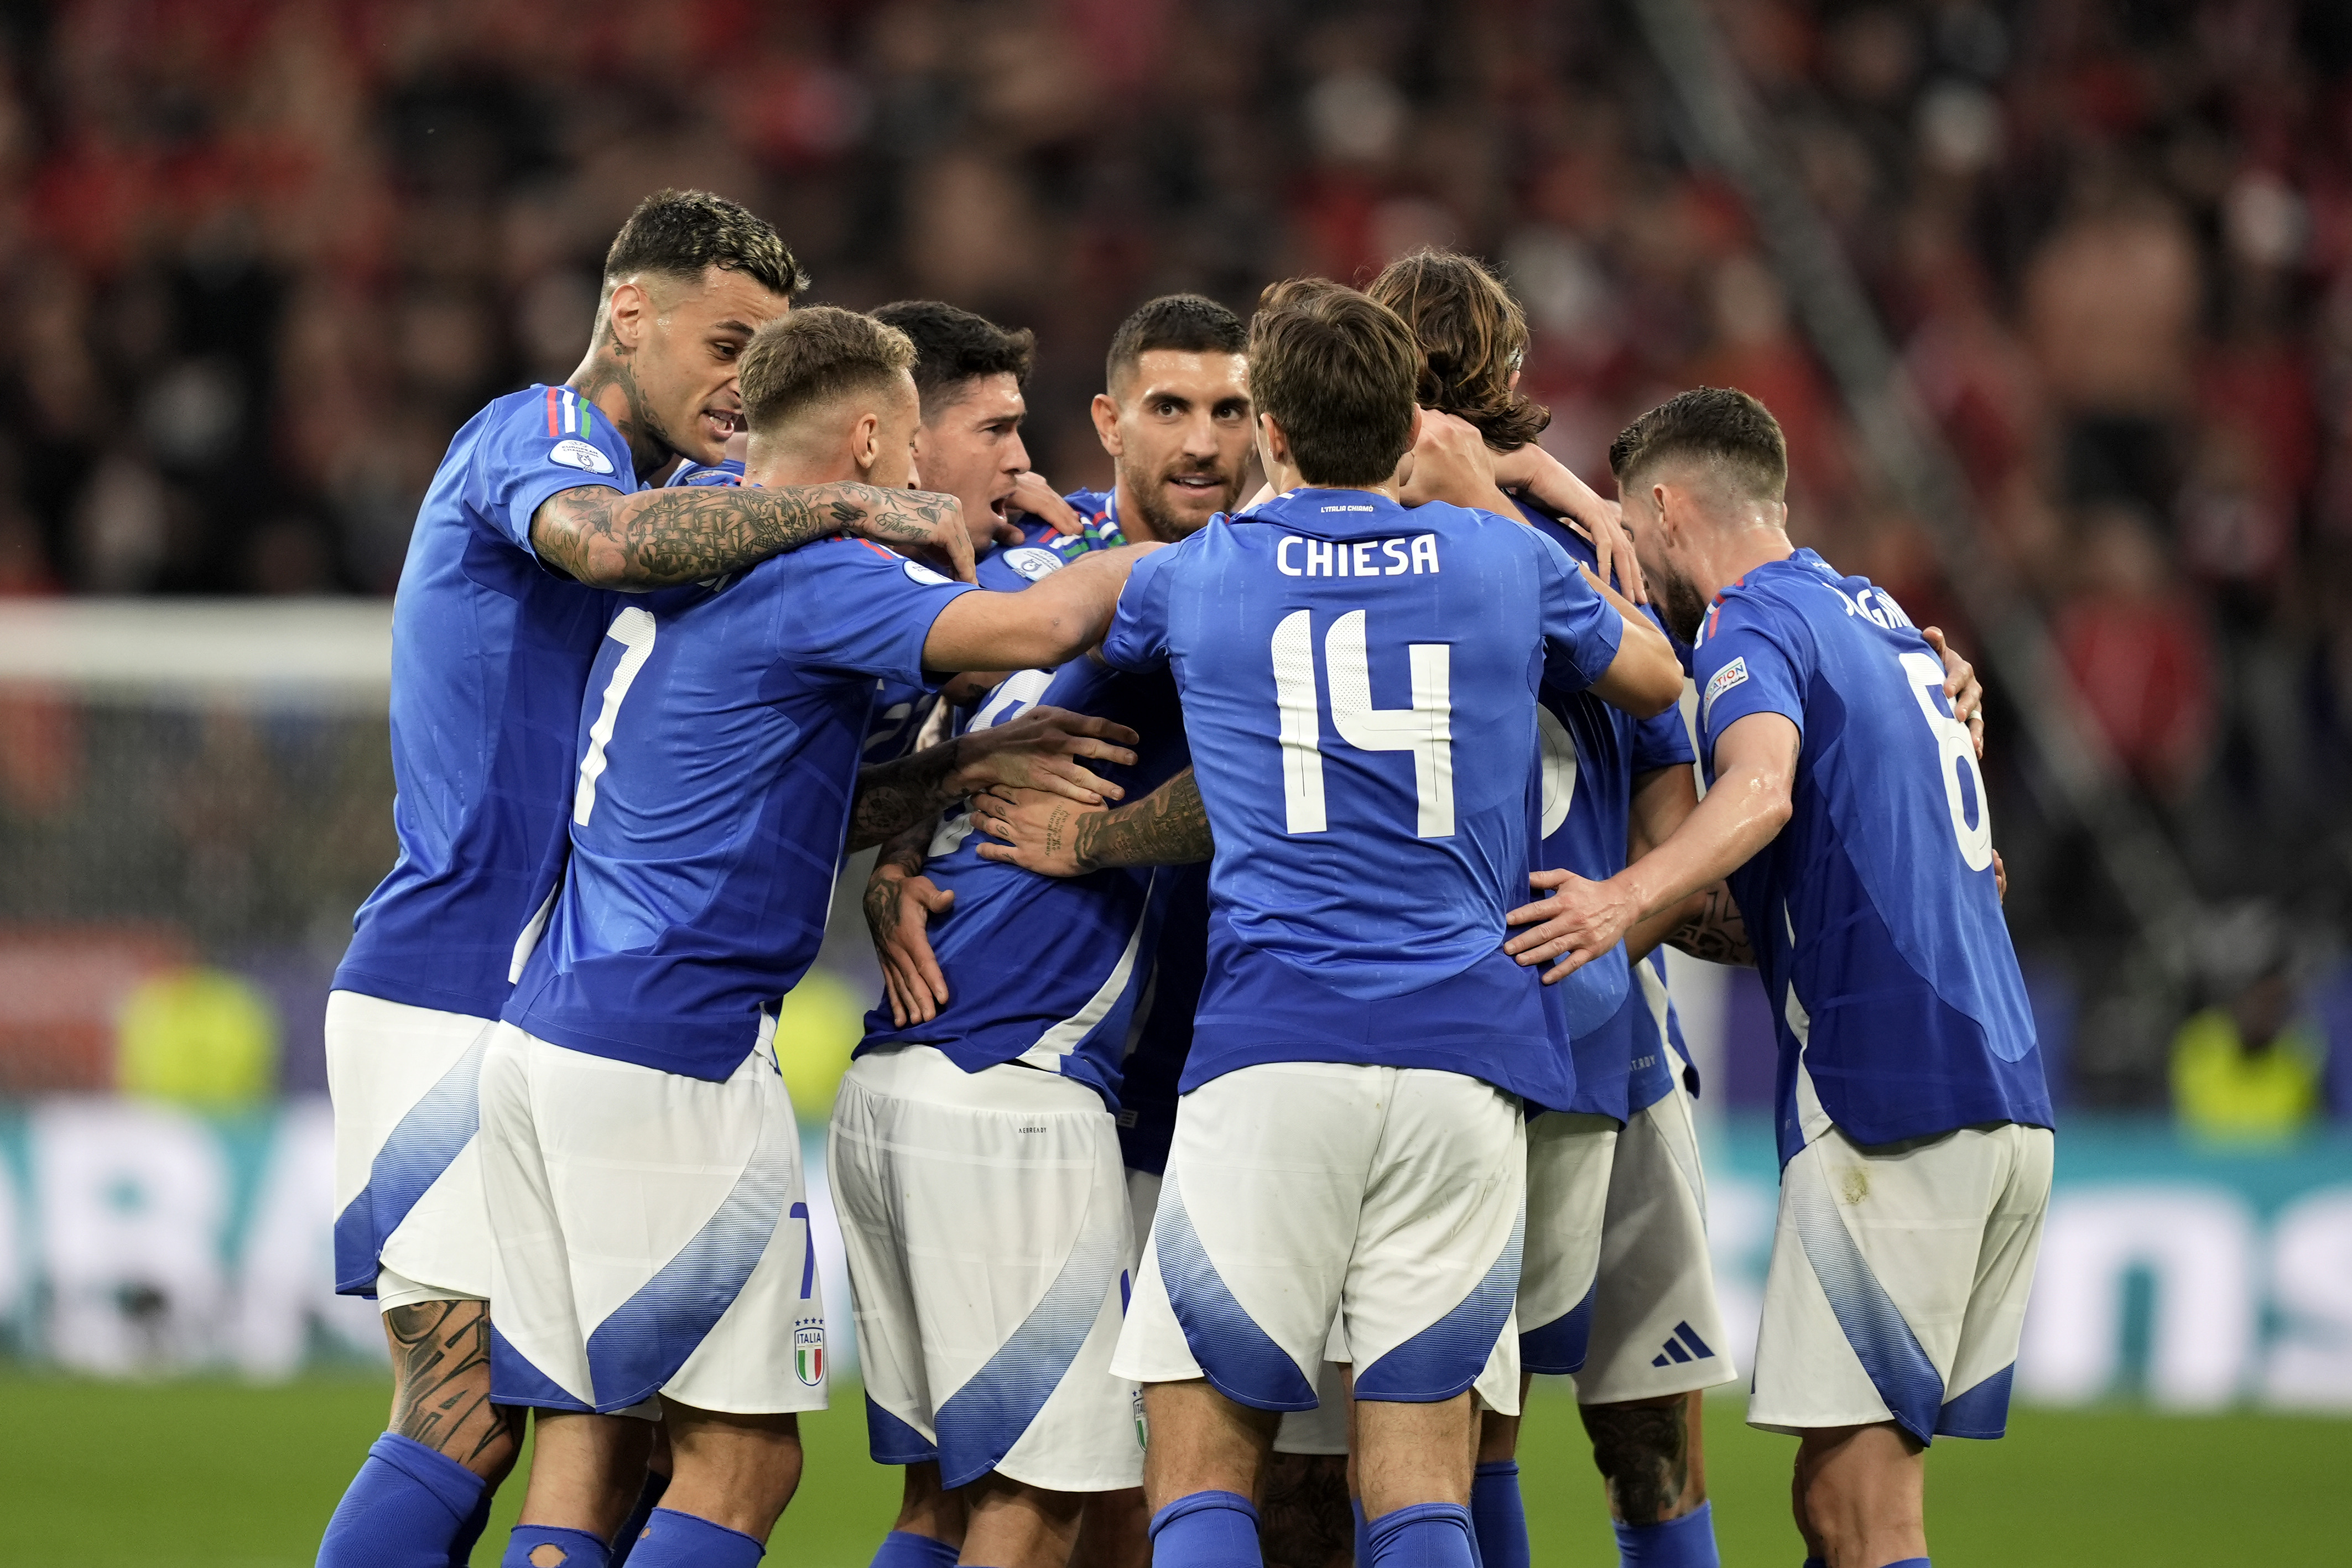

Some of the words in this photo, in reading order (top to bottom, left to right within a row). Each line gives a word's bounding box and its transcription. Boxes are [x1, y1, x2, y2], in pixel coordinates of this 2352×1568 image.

[1277, 534, 1440, 577] CHIESA
[573, 606, 657, 827] 7
[1271, 609, 1455, 838] 14
[1898, 653, 1993, 872] 6
[789, 1202, 814, 1299] 7
[797, 1332, 822, 1344] ITALIA
